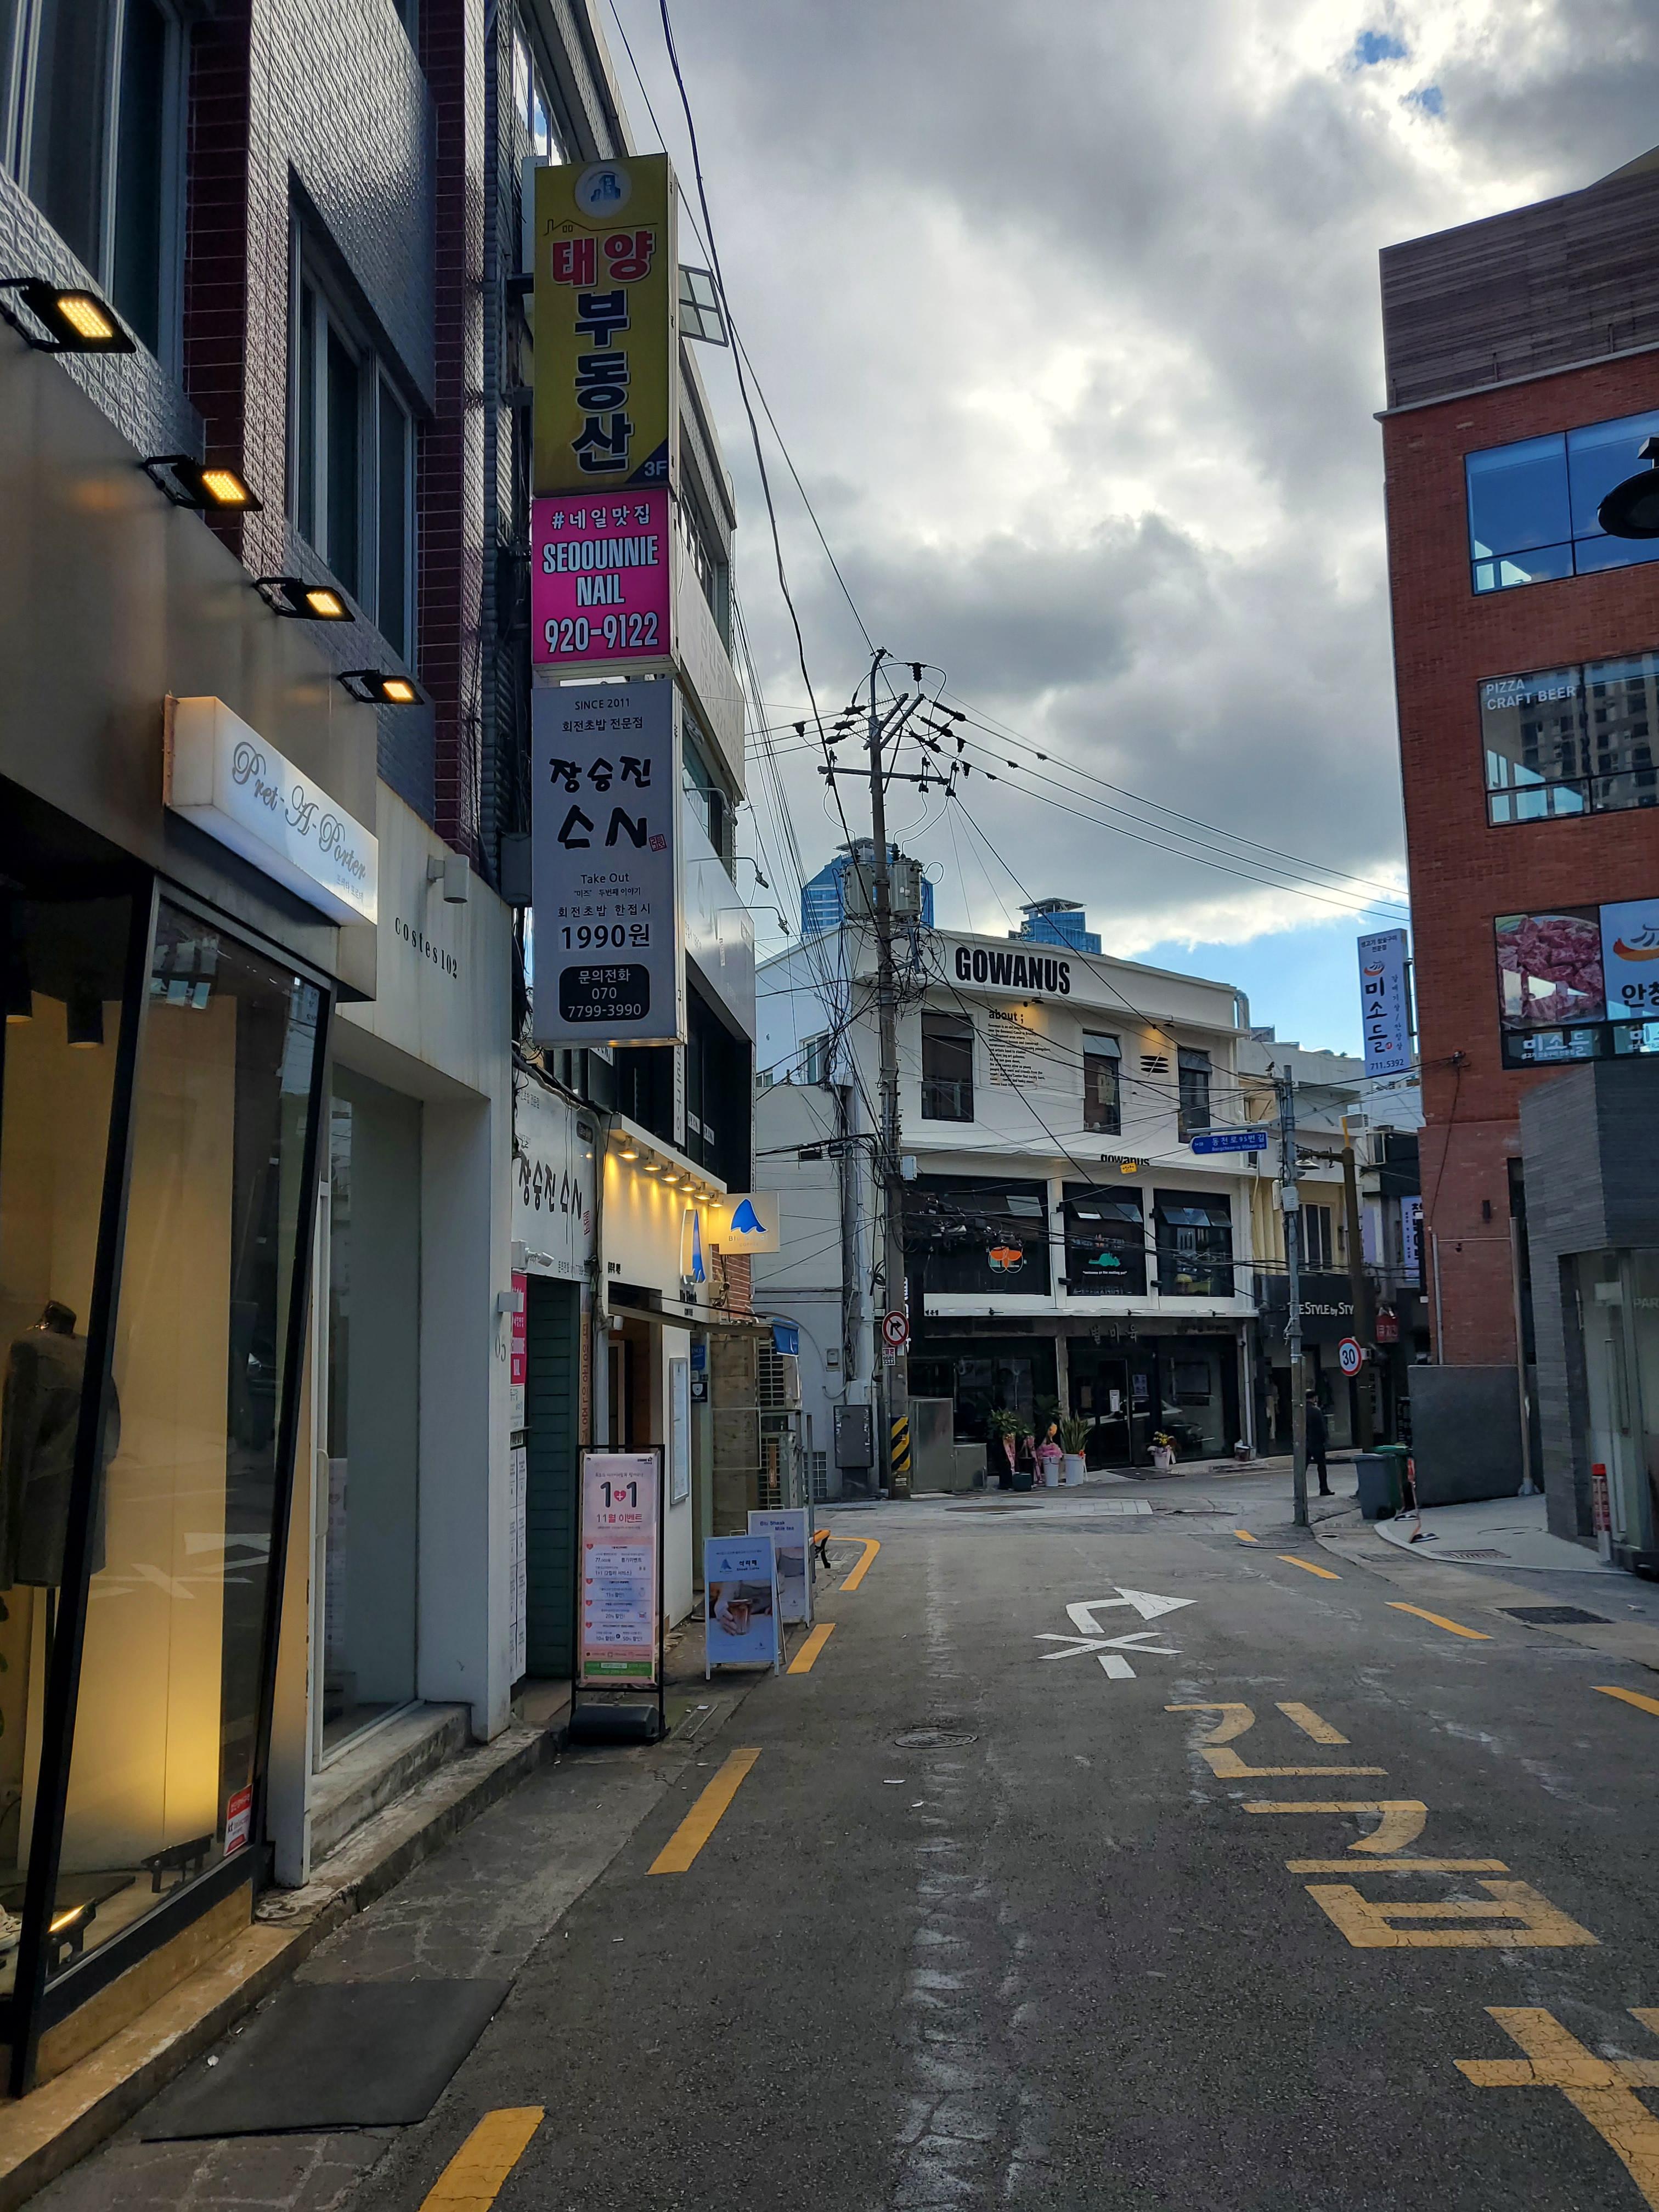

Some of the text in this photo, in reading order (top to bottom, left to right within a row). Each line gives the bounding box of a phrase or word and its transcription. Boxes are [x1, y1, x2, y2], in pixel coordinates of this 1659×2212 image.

[552, 230, 655, 287] 태양
[571, 288, 635, 475] 부동산
[644, 460, 668, 477] 3F
[552, 503, 650, 529] #네일맛집
[543, 535, 658, 574] SEOOUNNIE
[577, 574, 625, 606] NAIL
[545, 612, 658, 653] 920-9122
[1486, 679, 1525, 696] PIZZA
[575, 698, 630, 710] SINCE 2011
[1487, 686, 1576, 710] CRAFT BEER
[562, 716, 643, 732] 회전초밥 전문점
[549, 755, 651, 793] 장승진
[581, 873, 629, 884] Take Out
[557, 904, 651, 918] 회전초밥 한접시
[561, 923, 650, 950] 1990원
[394, 917, 458, 979] costes102
[578, 968, 631, 984] 문의전화
[955, 946, 1071, 995] GOWANUS
[591, 987, 617, 1000] 070
[567, 1003, 641, 1018] 7799-3990
[989, 1008, 1018, 1022] about
[1364, 976, 1389, 1053] 미소들
[1370, 1059, 1404, 1070] 711.5392
[1342, 1347, 1356, 1367] 30
[618, 1513, 643, 1523] 이벤트
